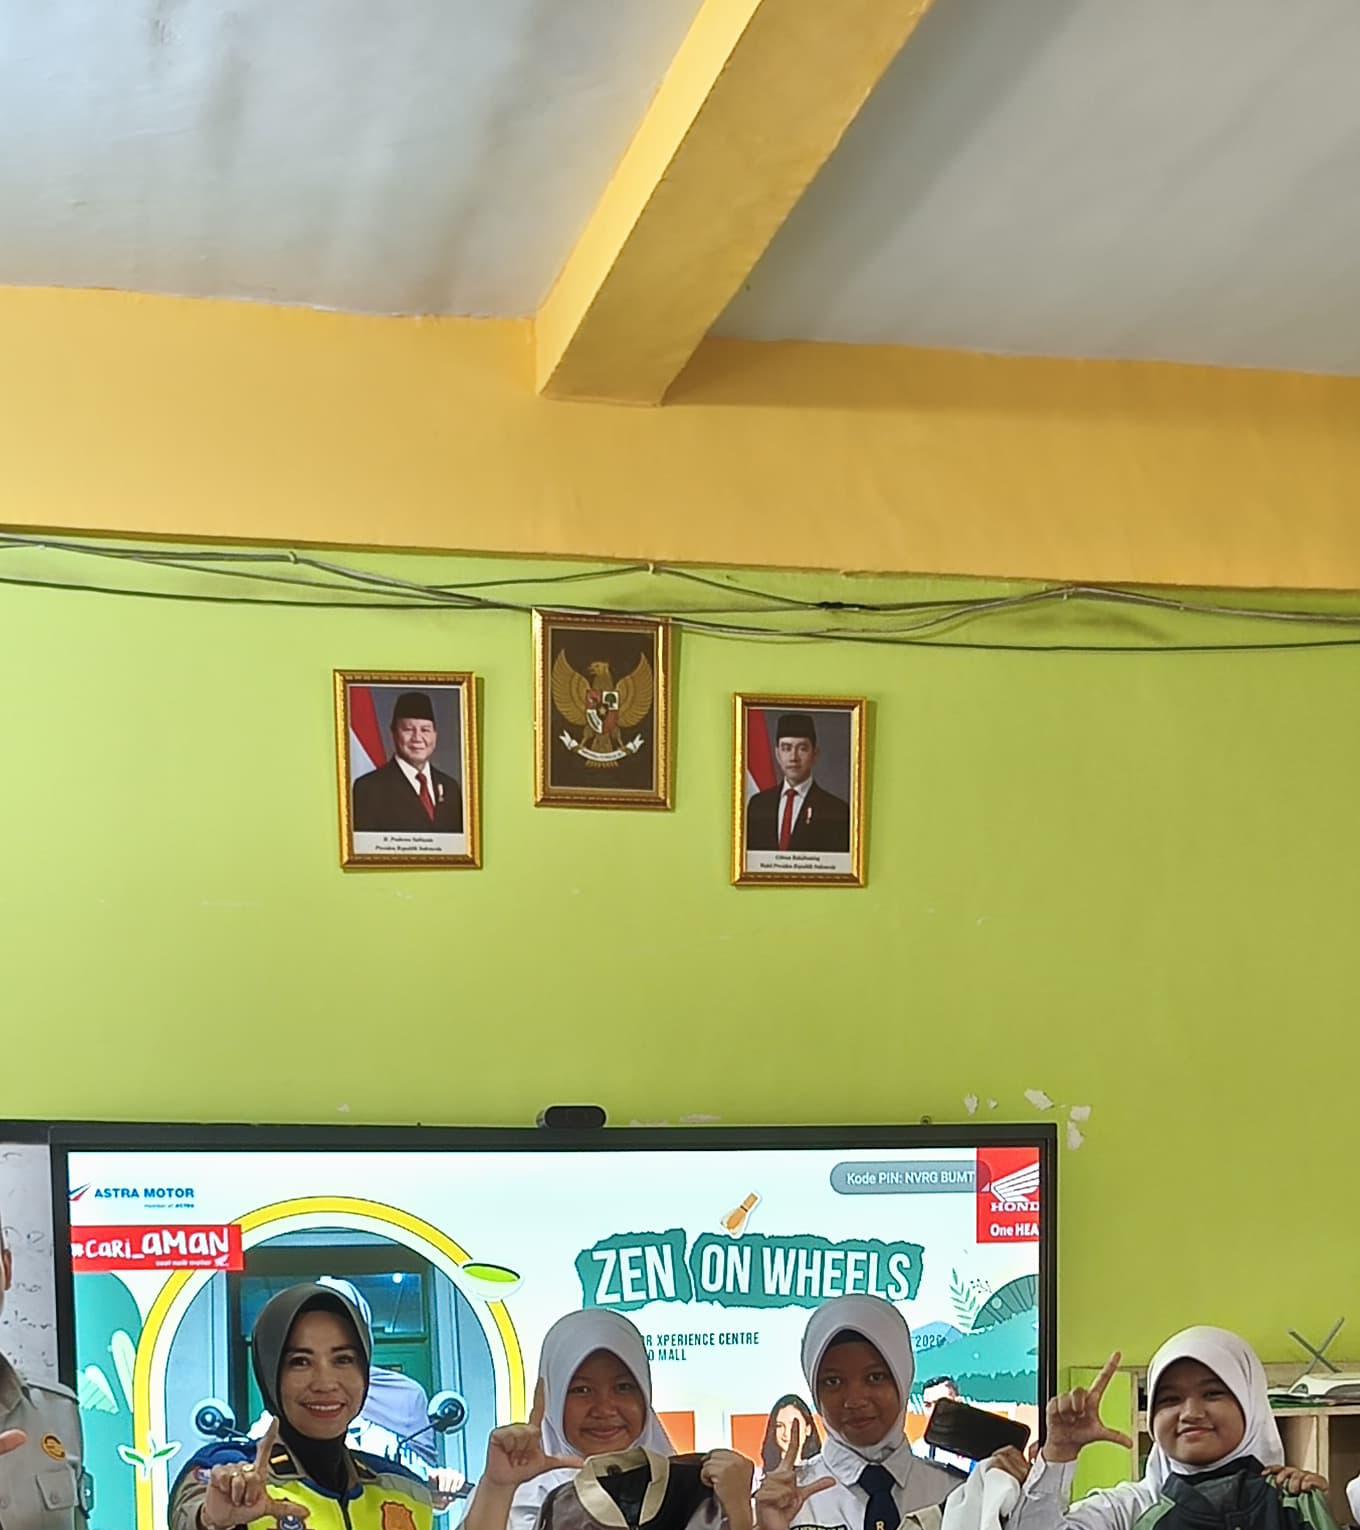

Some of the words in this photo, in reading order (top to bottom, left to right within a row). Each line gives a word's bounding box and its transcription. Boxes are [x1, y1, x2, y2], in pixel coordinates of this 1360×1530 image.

[847, 1172, 876, 1185] Kode
[878, 1171, 903, 1184] PIN:
[905, 1171, 938, 1184] NVRG
[94, 1188, 139, 1199] ASTRA
[144, 1188, 194, 1199] MOTOR
[991, 1201, 1039, 1212] HOND
[990, 1224, 1013, 1236] One
[1015, 1223, 1039, 1236] HEA
[592, 1244, 676, 1305] ZEN
[701, 1244, 750, 1294] ON
[762, 1247, 911, 1300] WHEELS
[657, 1333, 716, 1347] XPERIENCE
[718, 1332, 759, 1346] CENTRE
[658, 1349, 687, 1361] MALL
